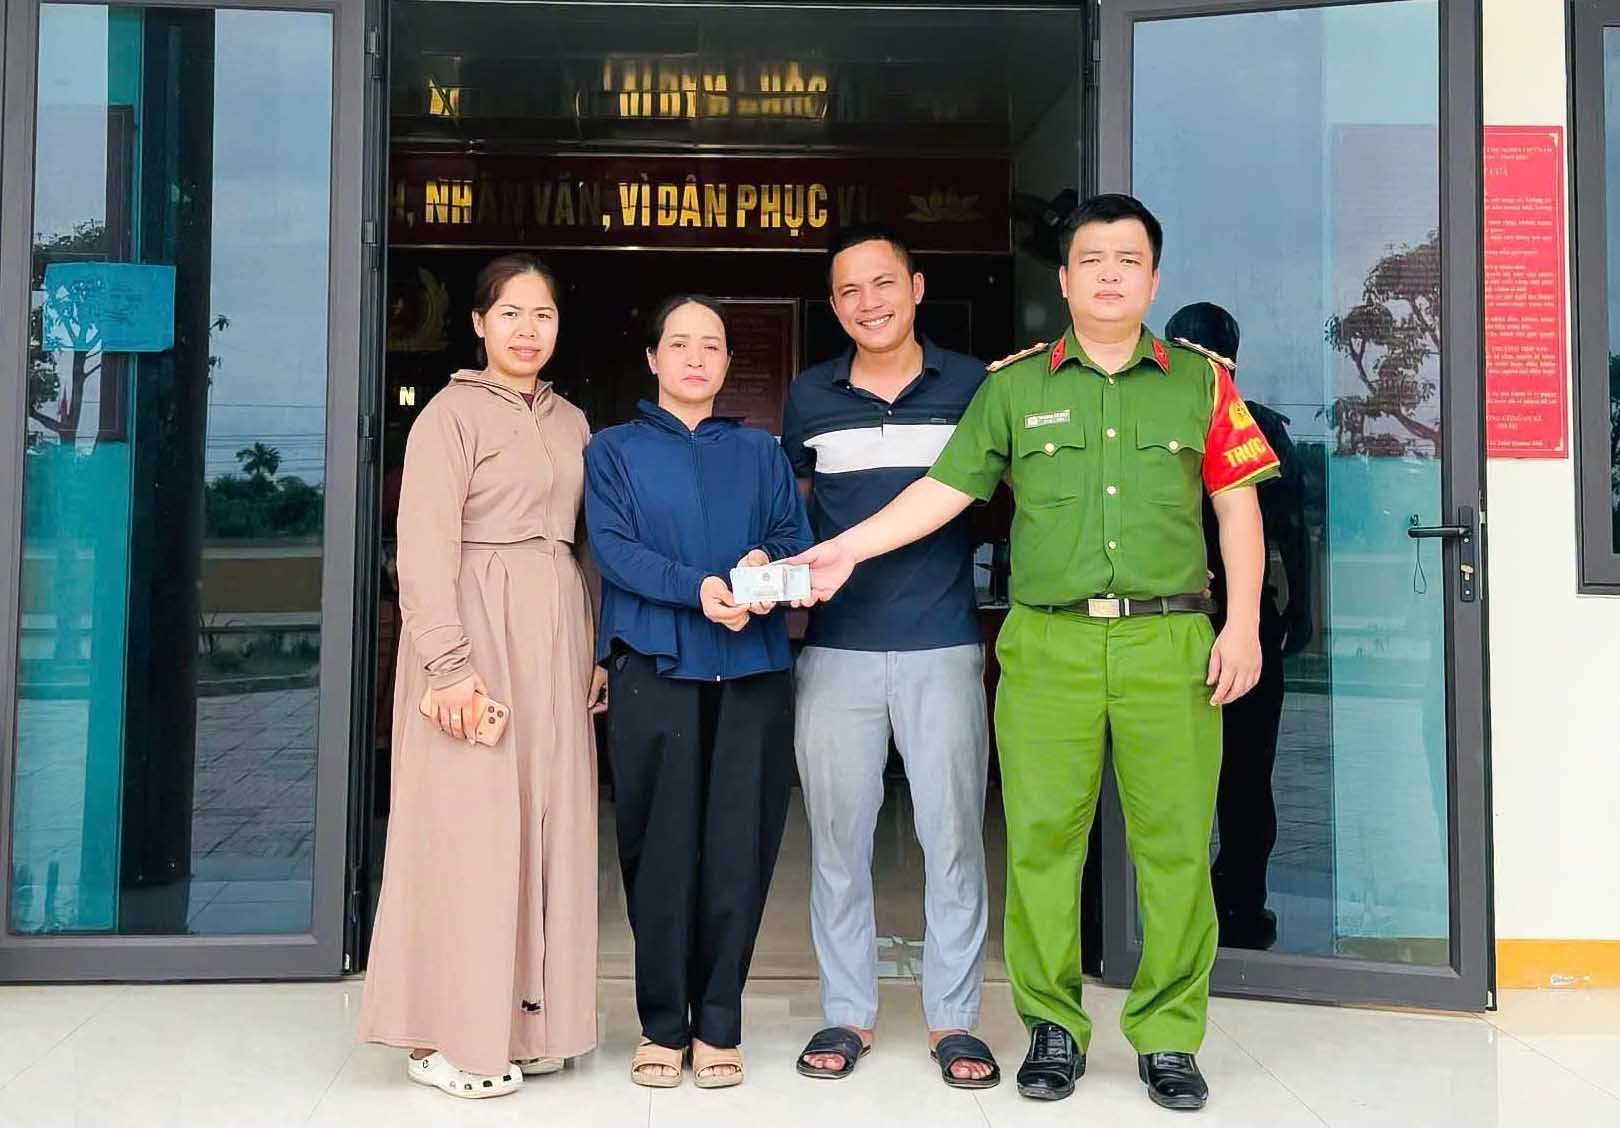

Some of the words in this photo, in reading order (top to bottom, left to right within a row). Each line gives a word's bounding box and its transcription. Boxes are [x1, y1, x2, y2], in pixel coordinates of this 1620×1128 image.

[617, 172, 651, 227] VÌ
[657, 174, 727, 228] DÂN
[735, 183, 830, 237] PHỤC
